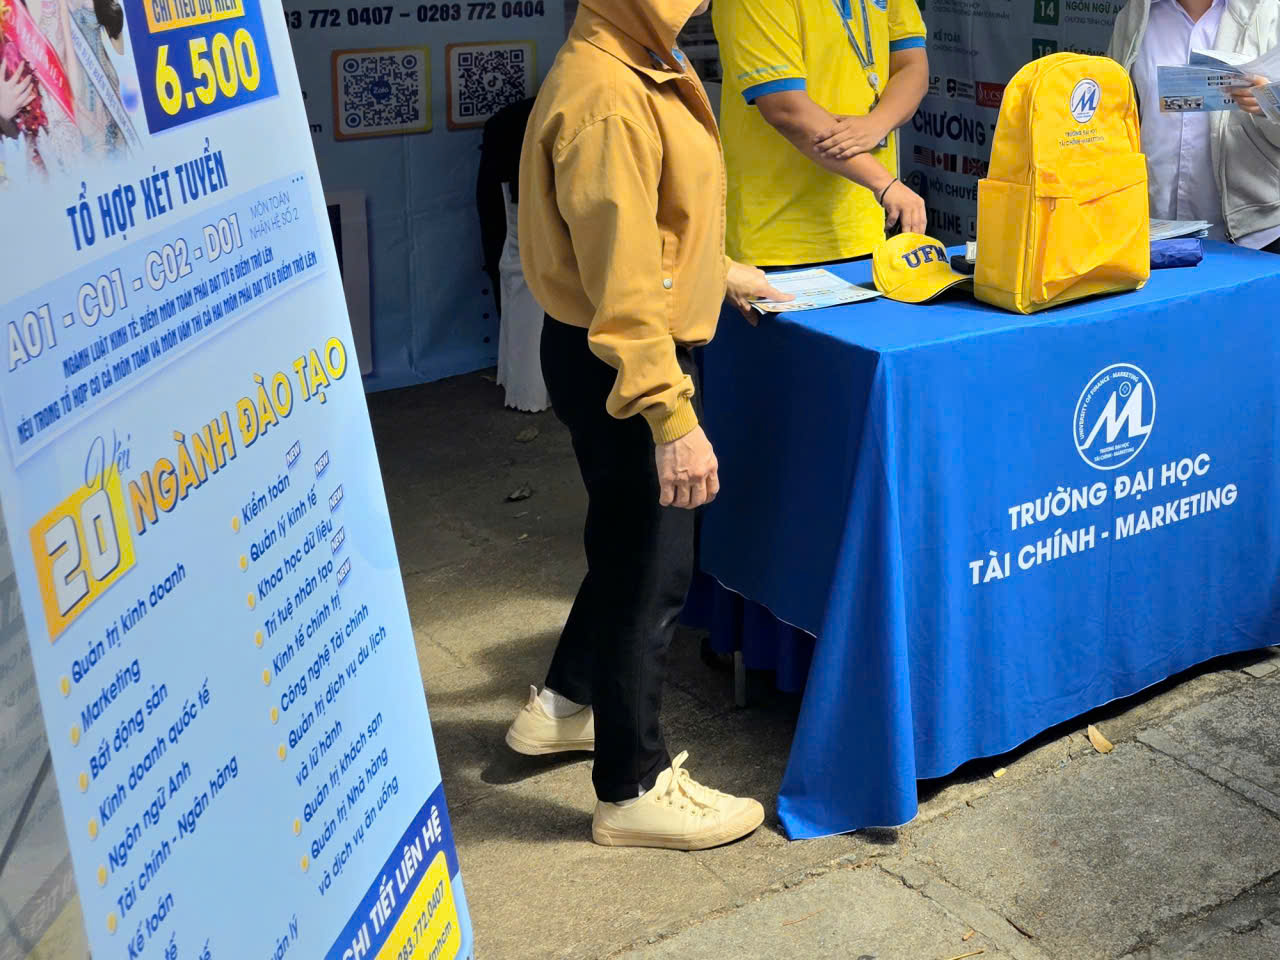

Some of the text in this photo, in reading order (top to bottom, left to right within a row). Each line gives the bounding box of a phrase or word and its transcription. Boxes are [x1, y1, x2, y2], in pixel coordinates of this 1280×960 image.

[308, 8, 341, 29] 772
[346, 6, 394, 27] 0407
[467, 2, 497, 21] 772
[502, 0, 546, 19] 0404
[155, 27, 261, 116] 6.500
[66, 137, 229, 251] TỔ HỢP XÉT TUYỂN
[8, 212, 244, 373] A01 C01 C02 D01
[128, 336, 347, 536] NGÀNH ĐÀO TẠO
[1008, 452, 1211, 531] TRƯỜNG ĐẠI HỌC
[43, 489, 121, 618] 20
[241, 473, 291, 526] Kiểm toán
[969, 483, 1239, 586] TÀI CHÍNH MARKETING
[71, 562, 186, 684] Quản trị kinh doanh
[280, 603, 370, 713] Công nghệ Tài chính
[81, 658, 142, 733] Marketing
[99, 676, 212, 827] Kinh doanh quốc tế
[342, 804, 442, 960] CHI TIẾT LIÊN HỆ
